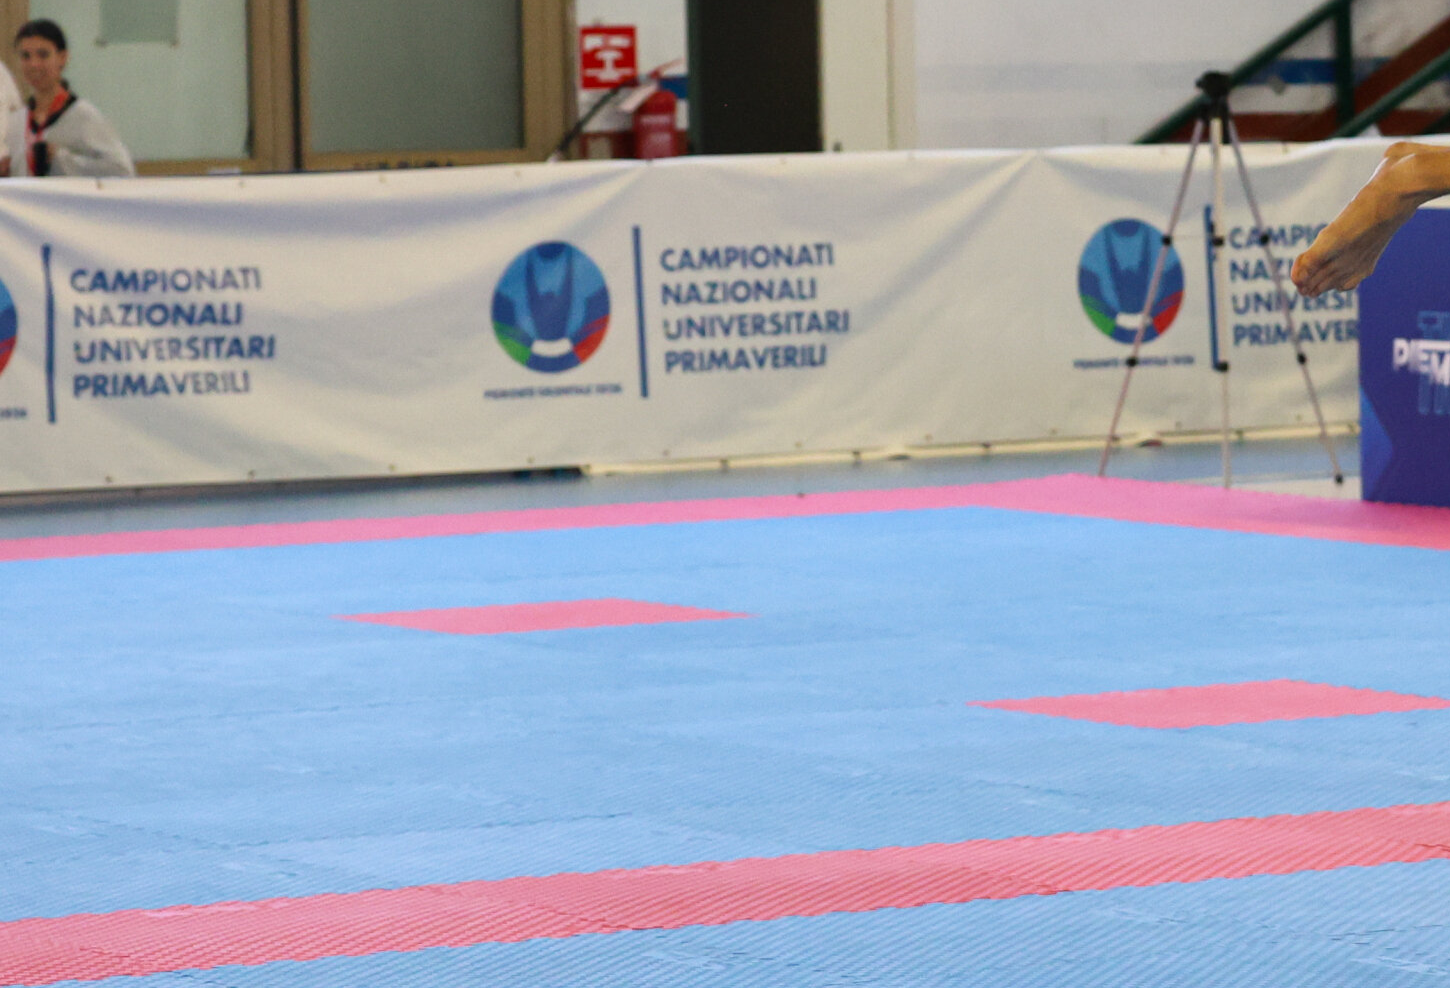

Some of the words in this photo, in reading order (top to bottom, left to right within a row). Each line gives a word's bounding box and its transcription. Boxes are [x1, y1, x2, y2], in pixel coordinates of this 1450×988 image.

[659, 241, 835, 272] CAMPIONATI
[69, 265, 263, 295] CAMPIONATI
[661, 277, 818, 307] NAZIONALI
[72, 302, 243, 330] NAZIONALI
[663, 309, 851, 341] UNIVERSITARI
[74, 335, 276, 367] UNIVERSITARI
[664, 344, 828, 376] PRIMAVERILI
[72, 370, 251, 402] PRIMAVERILI
